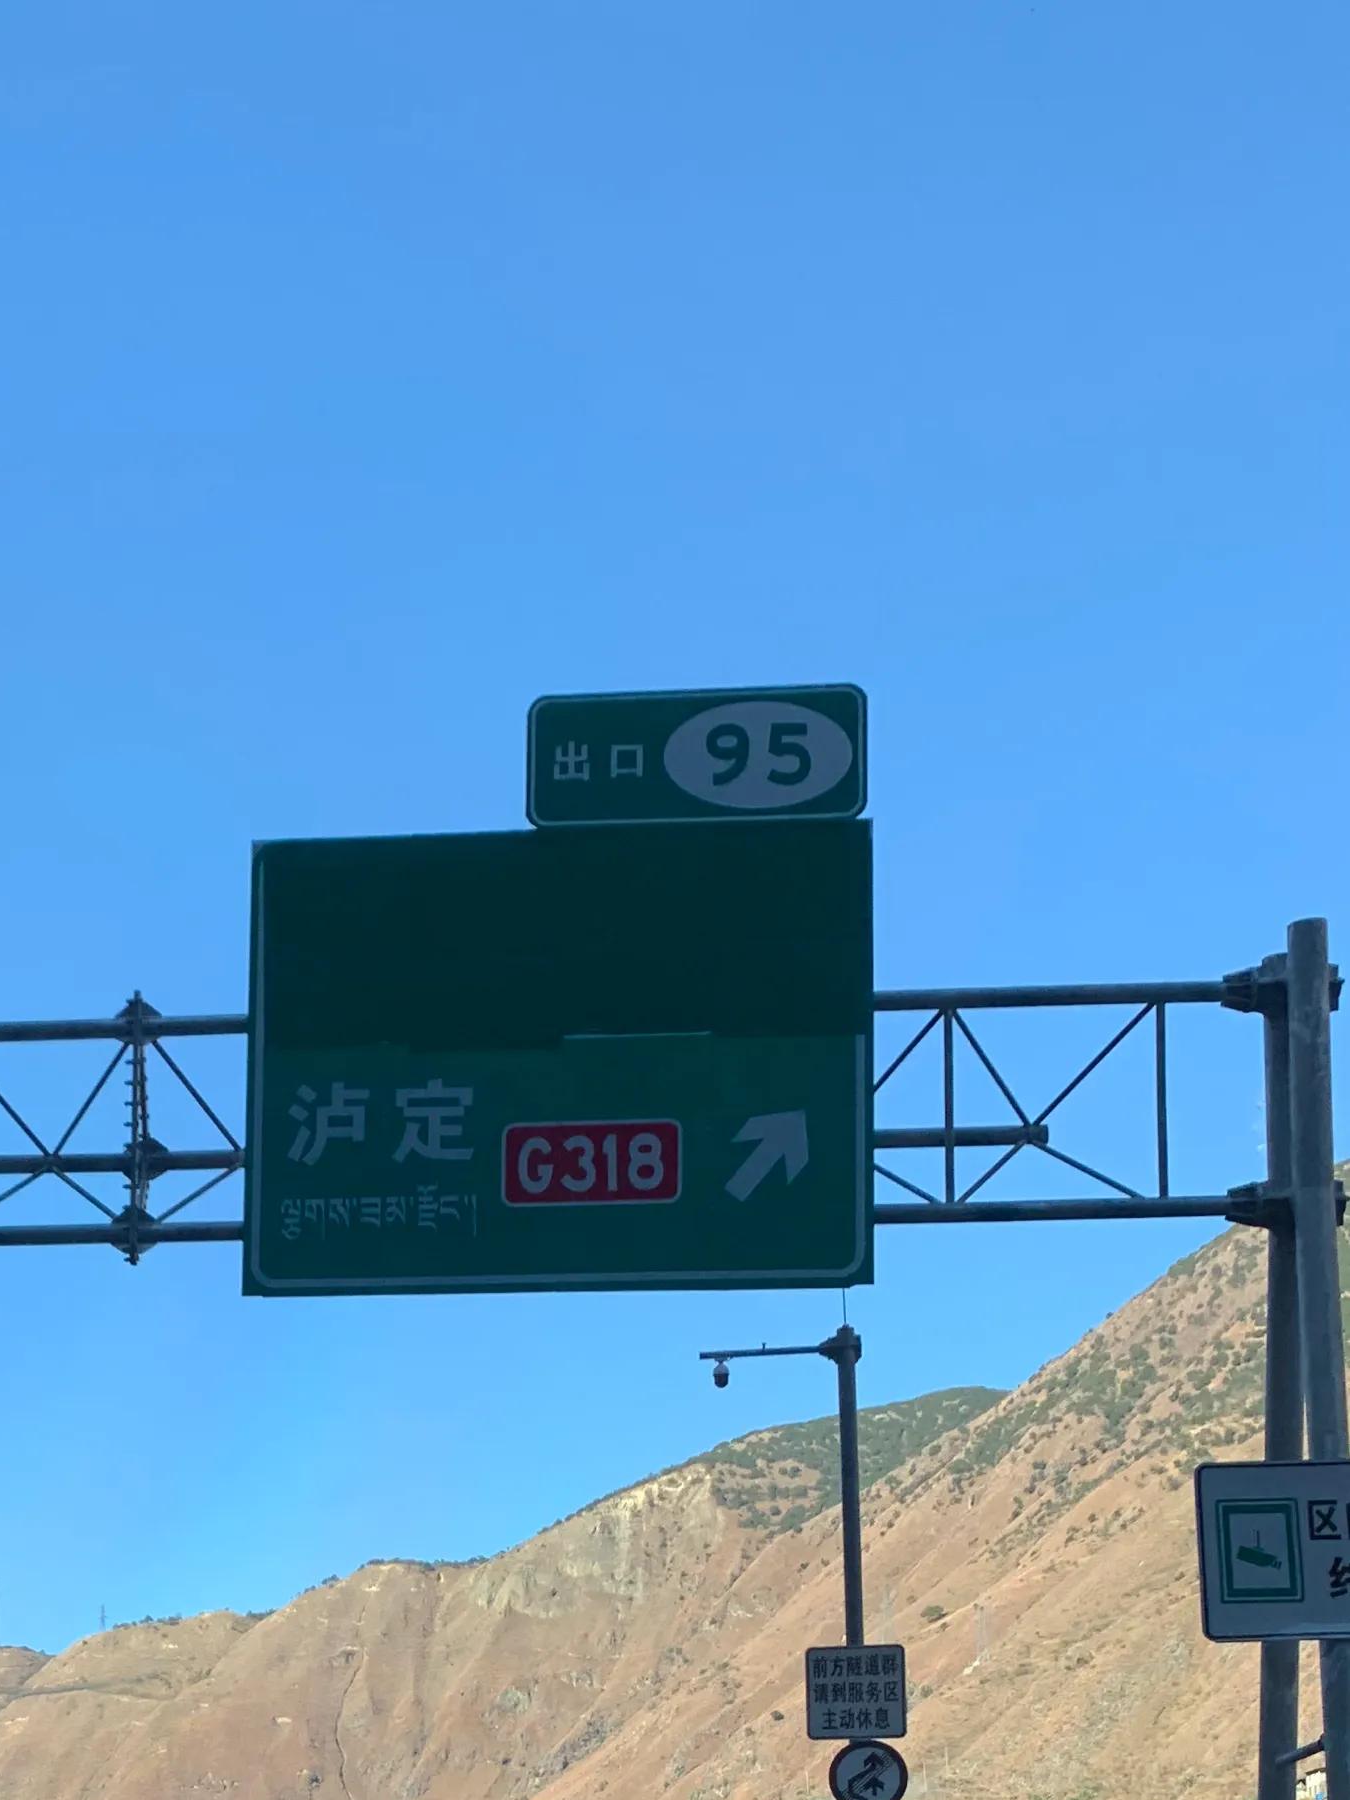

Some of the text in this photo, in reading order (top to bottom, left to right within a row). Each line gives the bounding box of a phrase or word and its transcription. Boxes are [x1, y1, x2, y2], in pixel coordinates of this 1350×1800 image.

[553, 740, 644, 782] 出口
[705, 722, 812, 787] 95
[286, 1078, 475, 1166] 泸定
[517, 1132, 665, 1195] G318
[1307, 1499, 1350, 1541] 区
[811, 1654, 900, 1679] 前方隧道群
[821, 1708, 891, 1731] 主动休息
